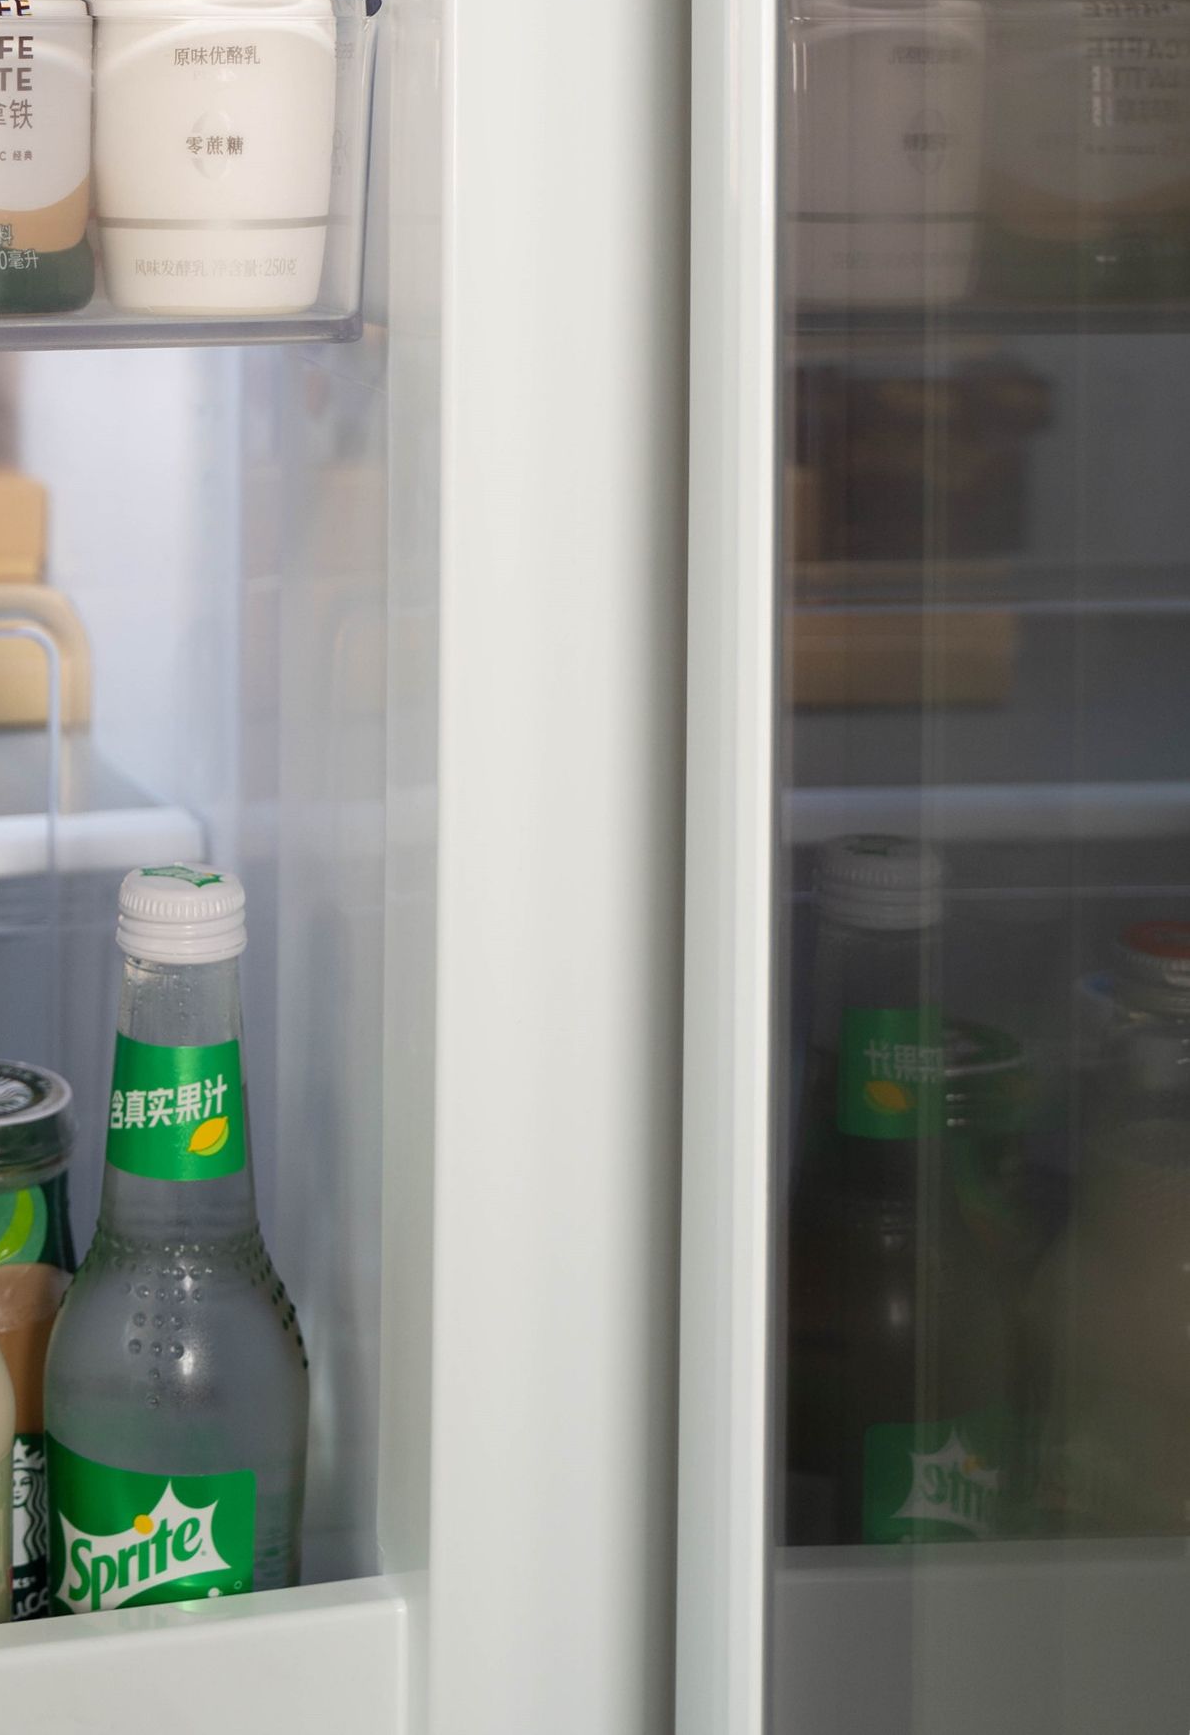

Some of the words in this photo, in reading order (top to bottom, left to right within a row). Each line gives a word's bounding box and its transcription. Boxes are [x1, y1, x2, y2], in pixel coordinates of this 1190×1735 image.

[173, 45, 261, 67] 原味优酪乳
[186, 136, 244, 155] 零蔗糖
[110, 1074, 228, 1129] 含真实果汁
[68, 1514, 204, 1612] Sprite
